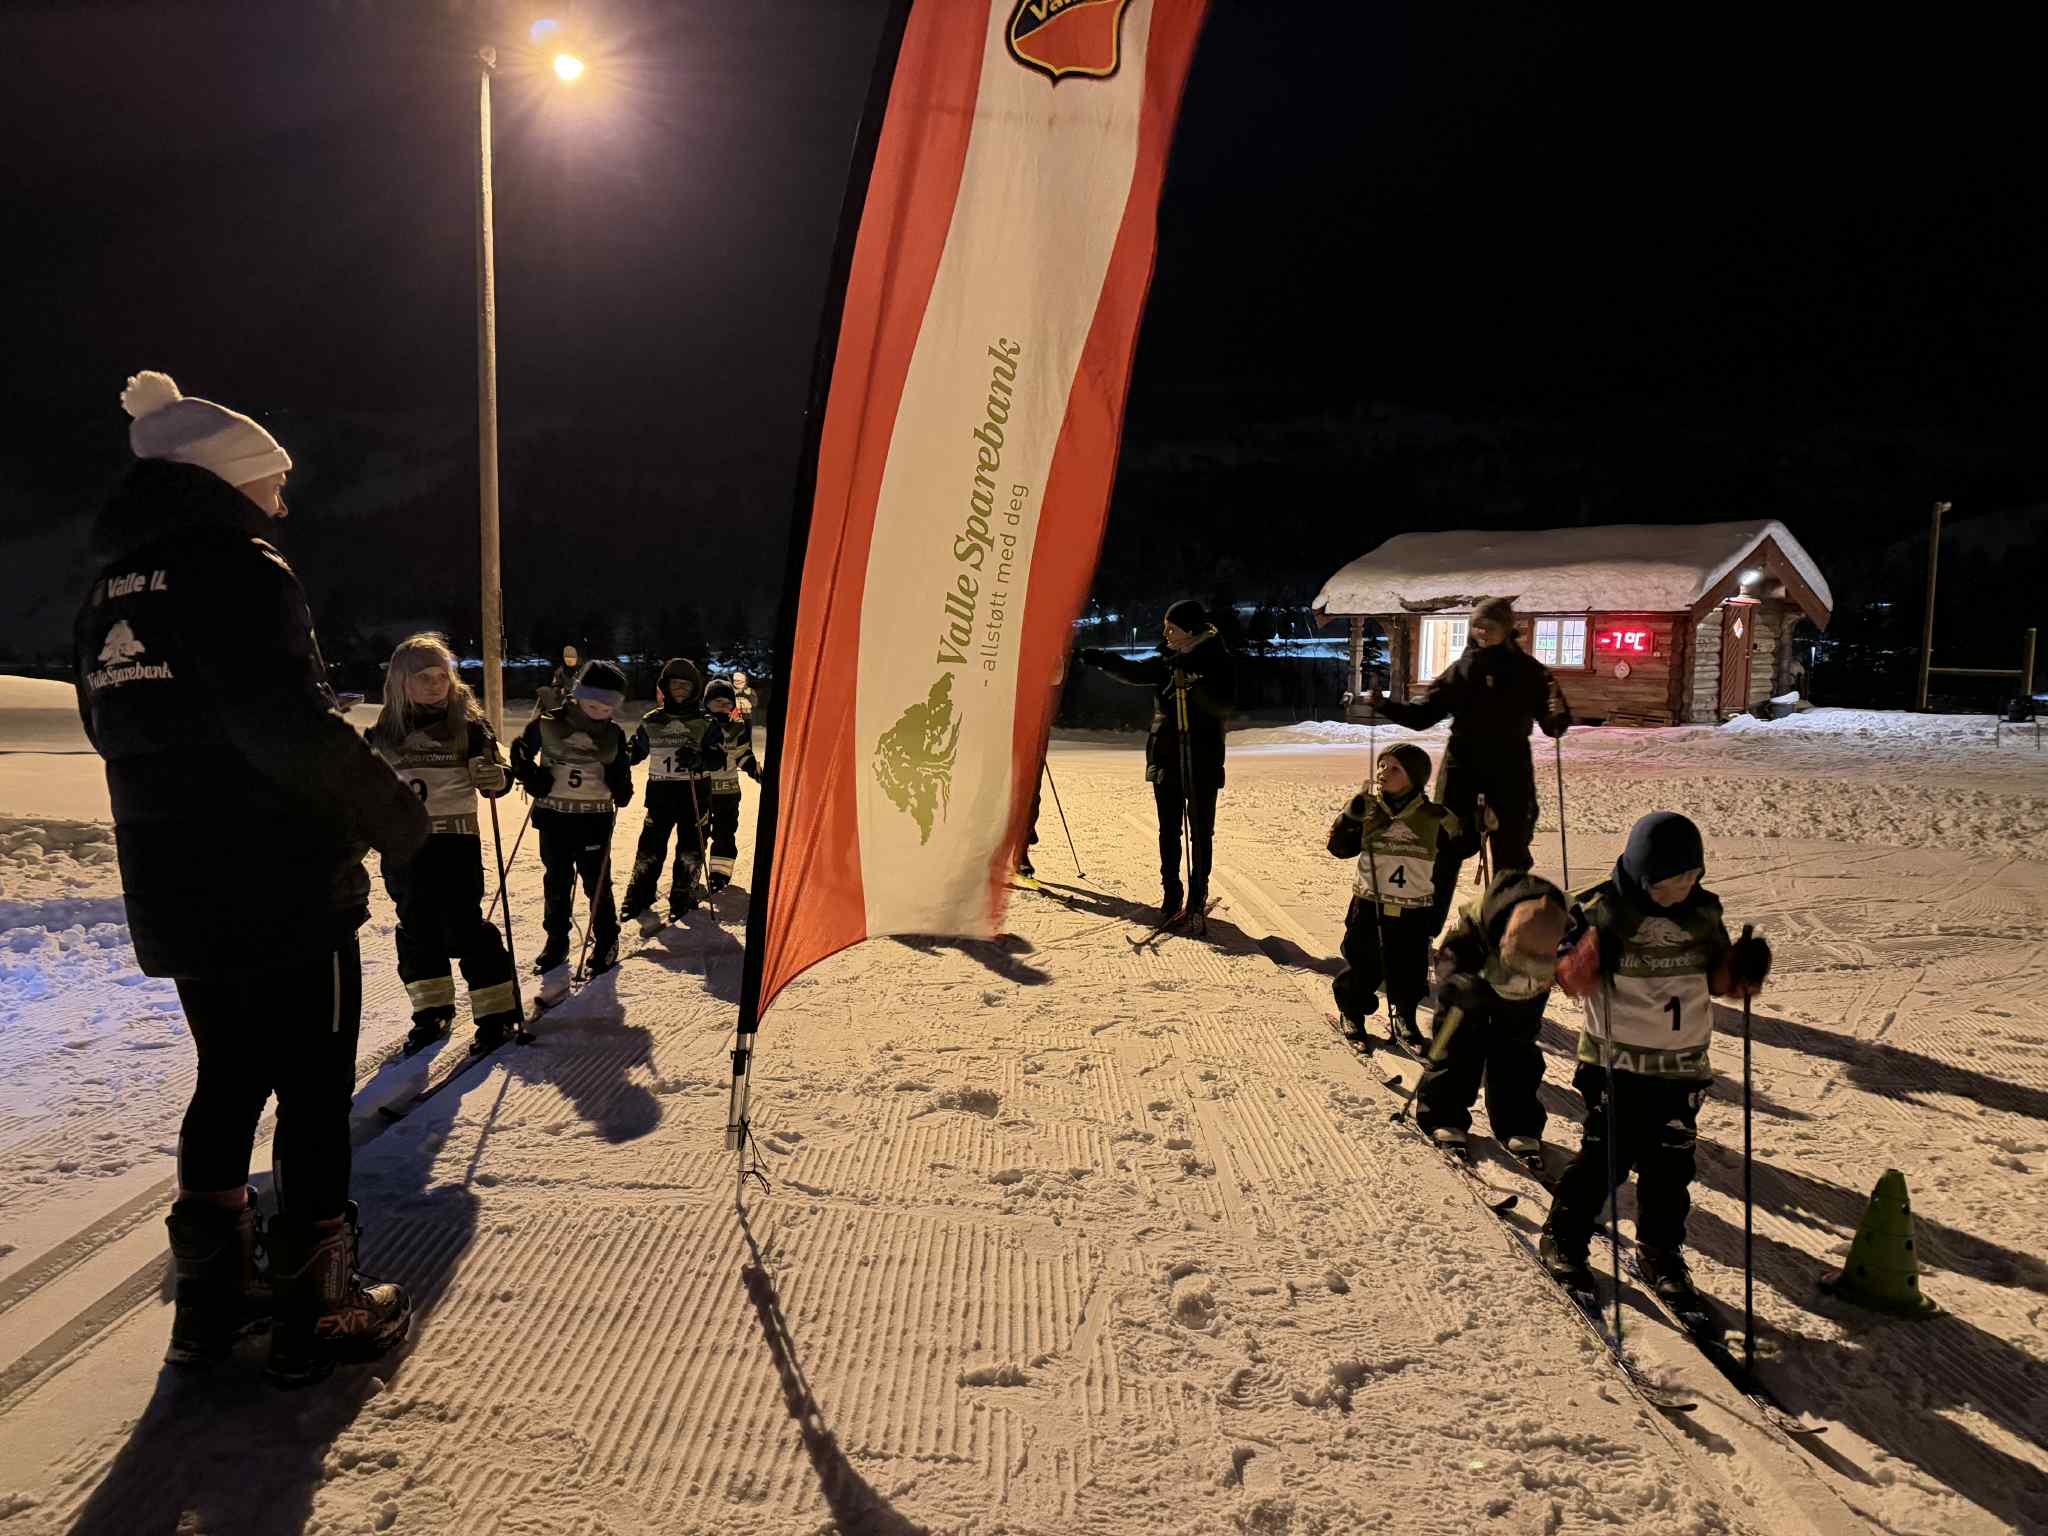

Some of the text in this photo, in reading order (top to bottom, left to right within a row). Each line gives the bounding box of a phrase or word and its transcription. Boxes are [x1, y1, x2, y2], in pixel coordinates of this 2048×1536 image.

[937, 337, 1021, 664] Valle Sparebank
[1004, 484, 1029, 525] deg
[997, 533, 1016, 583] med
[107, 572, 146, 599] Valle
[980, 592, 1008, 671] allstøtt
[567, 769, 583, 789] 5
[1388, 864, 1407, 889] 4
[1664, 996, 1682, 1031] 1
[1612, 1051, 1697, 1073] ALLE
